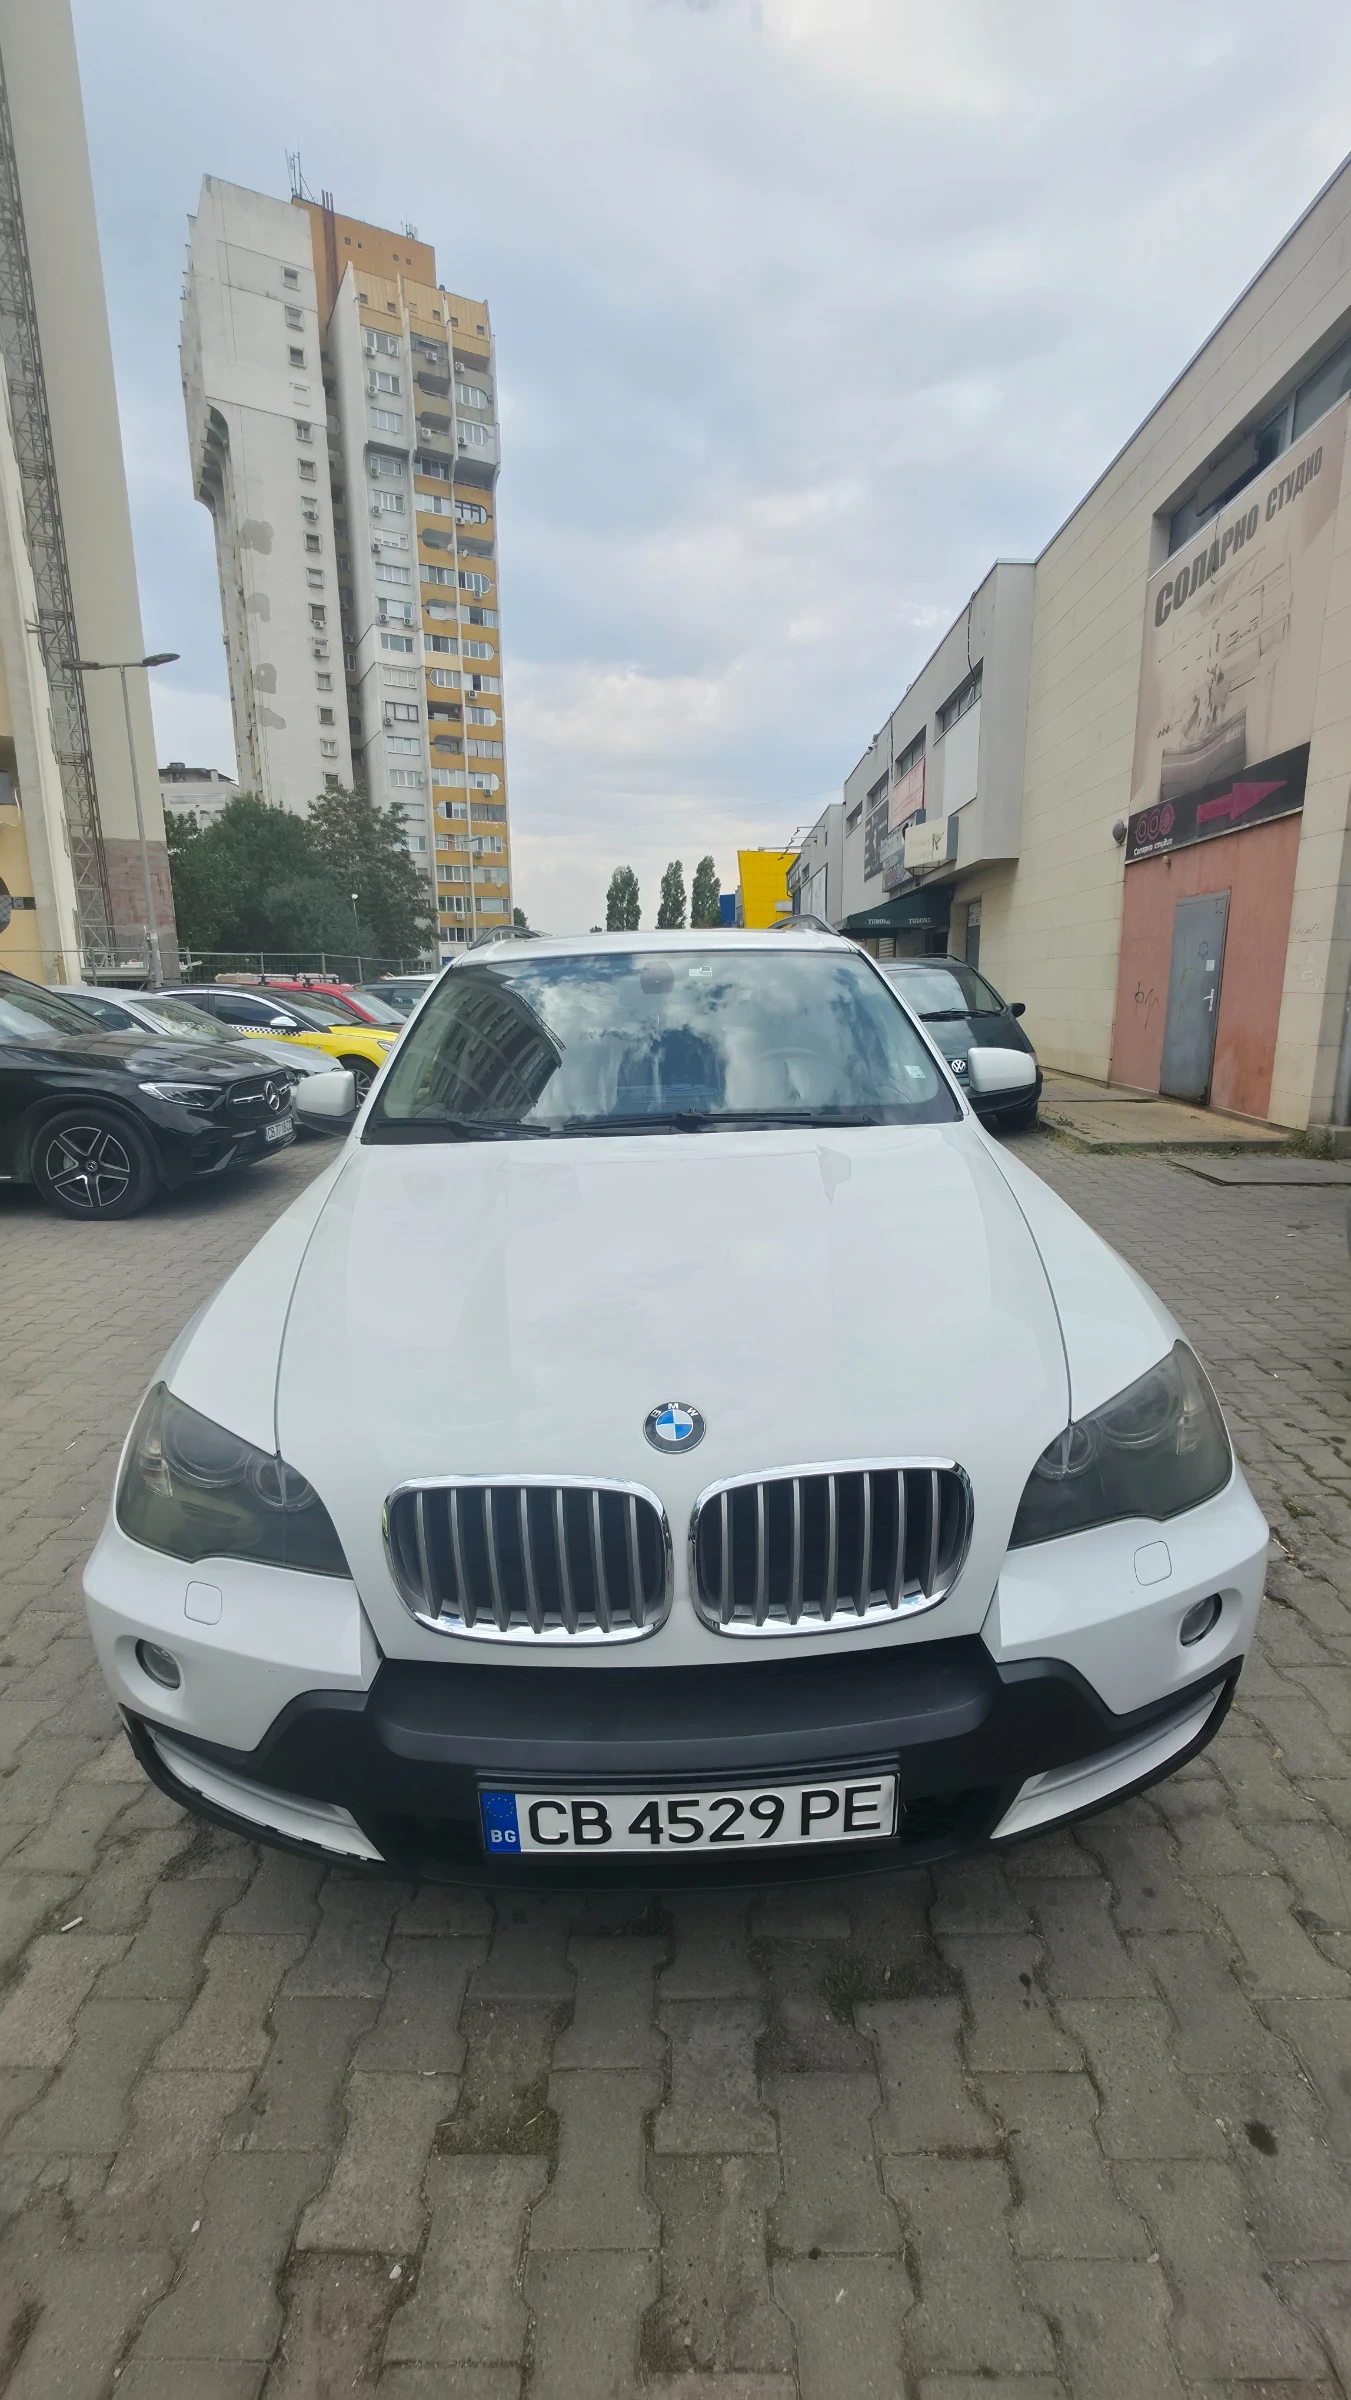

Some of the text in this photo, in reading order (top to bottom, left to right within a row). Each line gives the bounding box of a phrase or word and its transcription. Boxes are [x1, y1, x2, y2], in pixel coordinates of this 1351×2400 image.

[1154, 446, 1324, 628] СОЛАРНО СТУДИО
[650, 1402, 698, 1418] BMW
[528, 1783, 882, 1845] CB 4529 PE
[490, 1828, 517, 1844] BG
